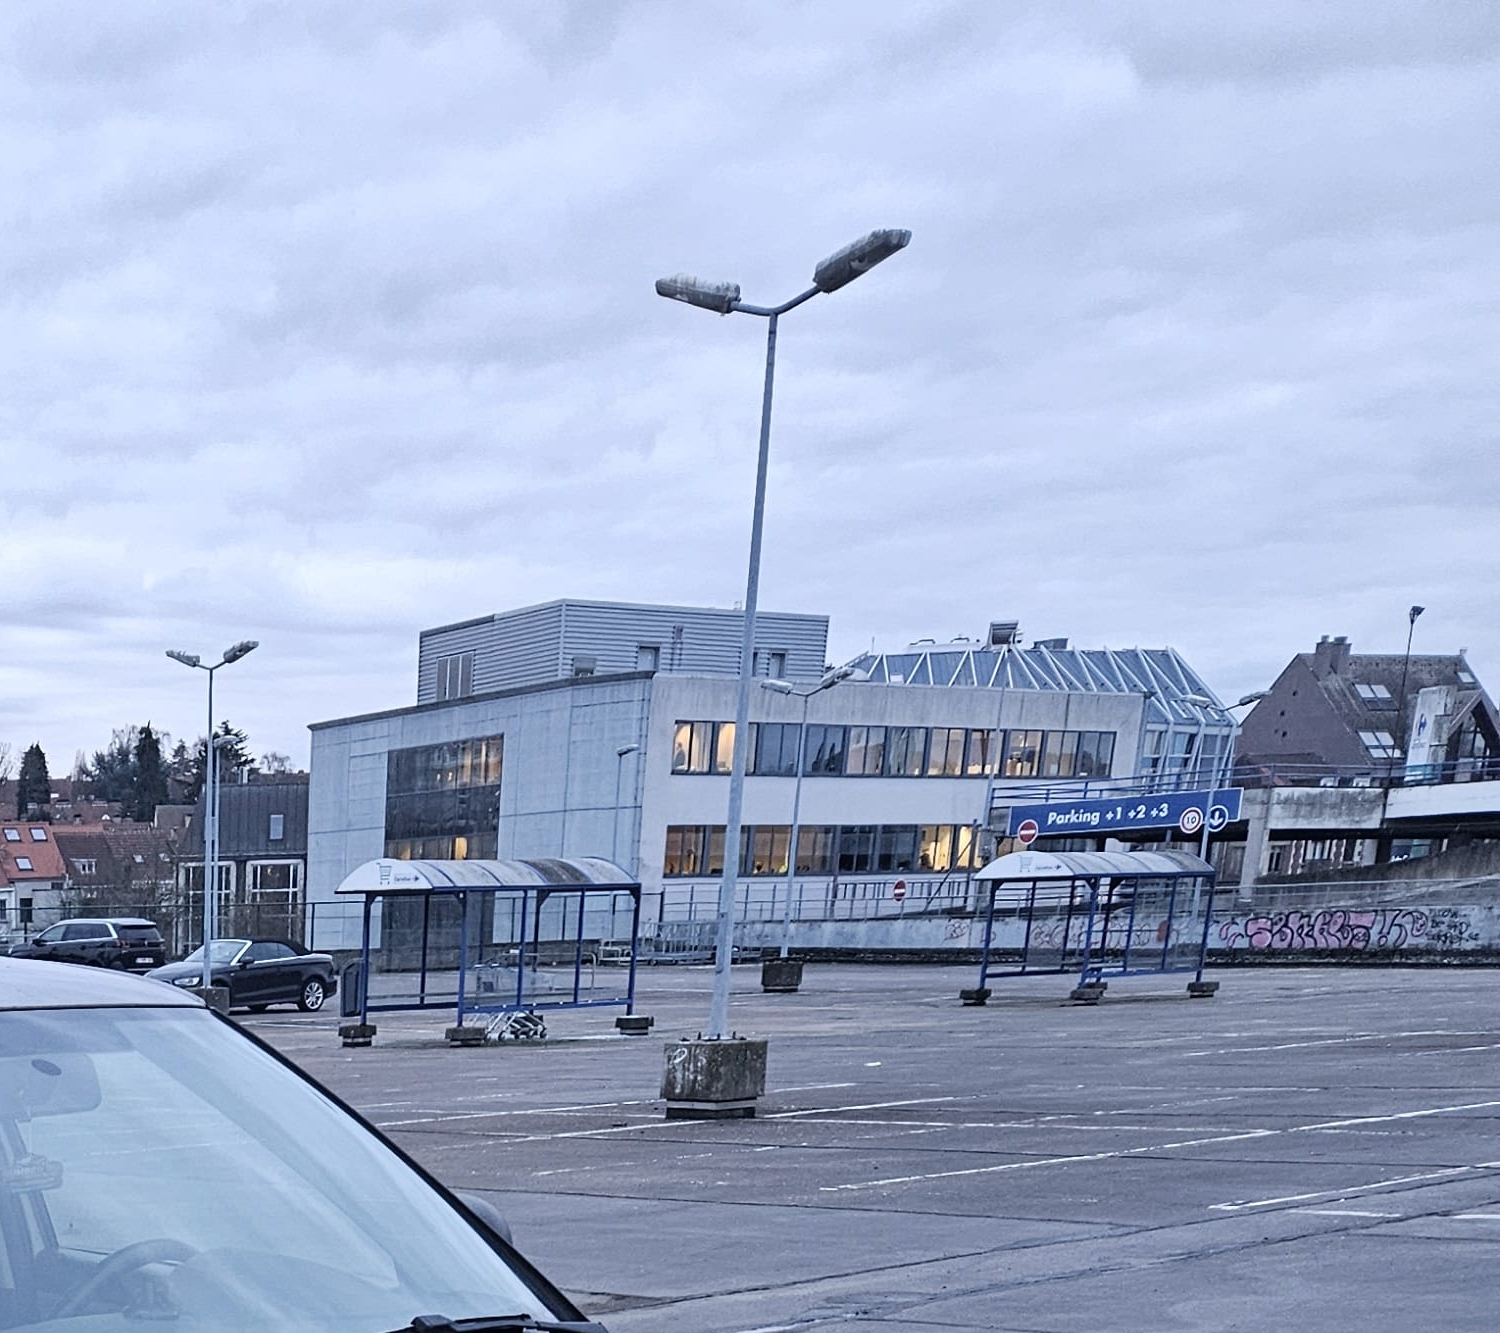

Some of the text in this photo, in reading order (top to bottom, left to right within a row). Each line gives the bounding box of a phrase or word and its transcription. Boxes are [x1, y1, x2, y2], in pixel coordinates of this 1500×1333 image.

[1047, 803, 1169, 825] Parking +1 +2 +3
[1186, 815, 1197, 824] 10
